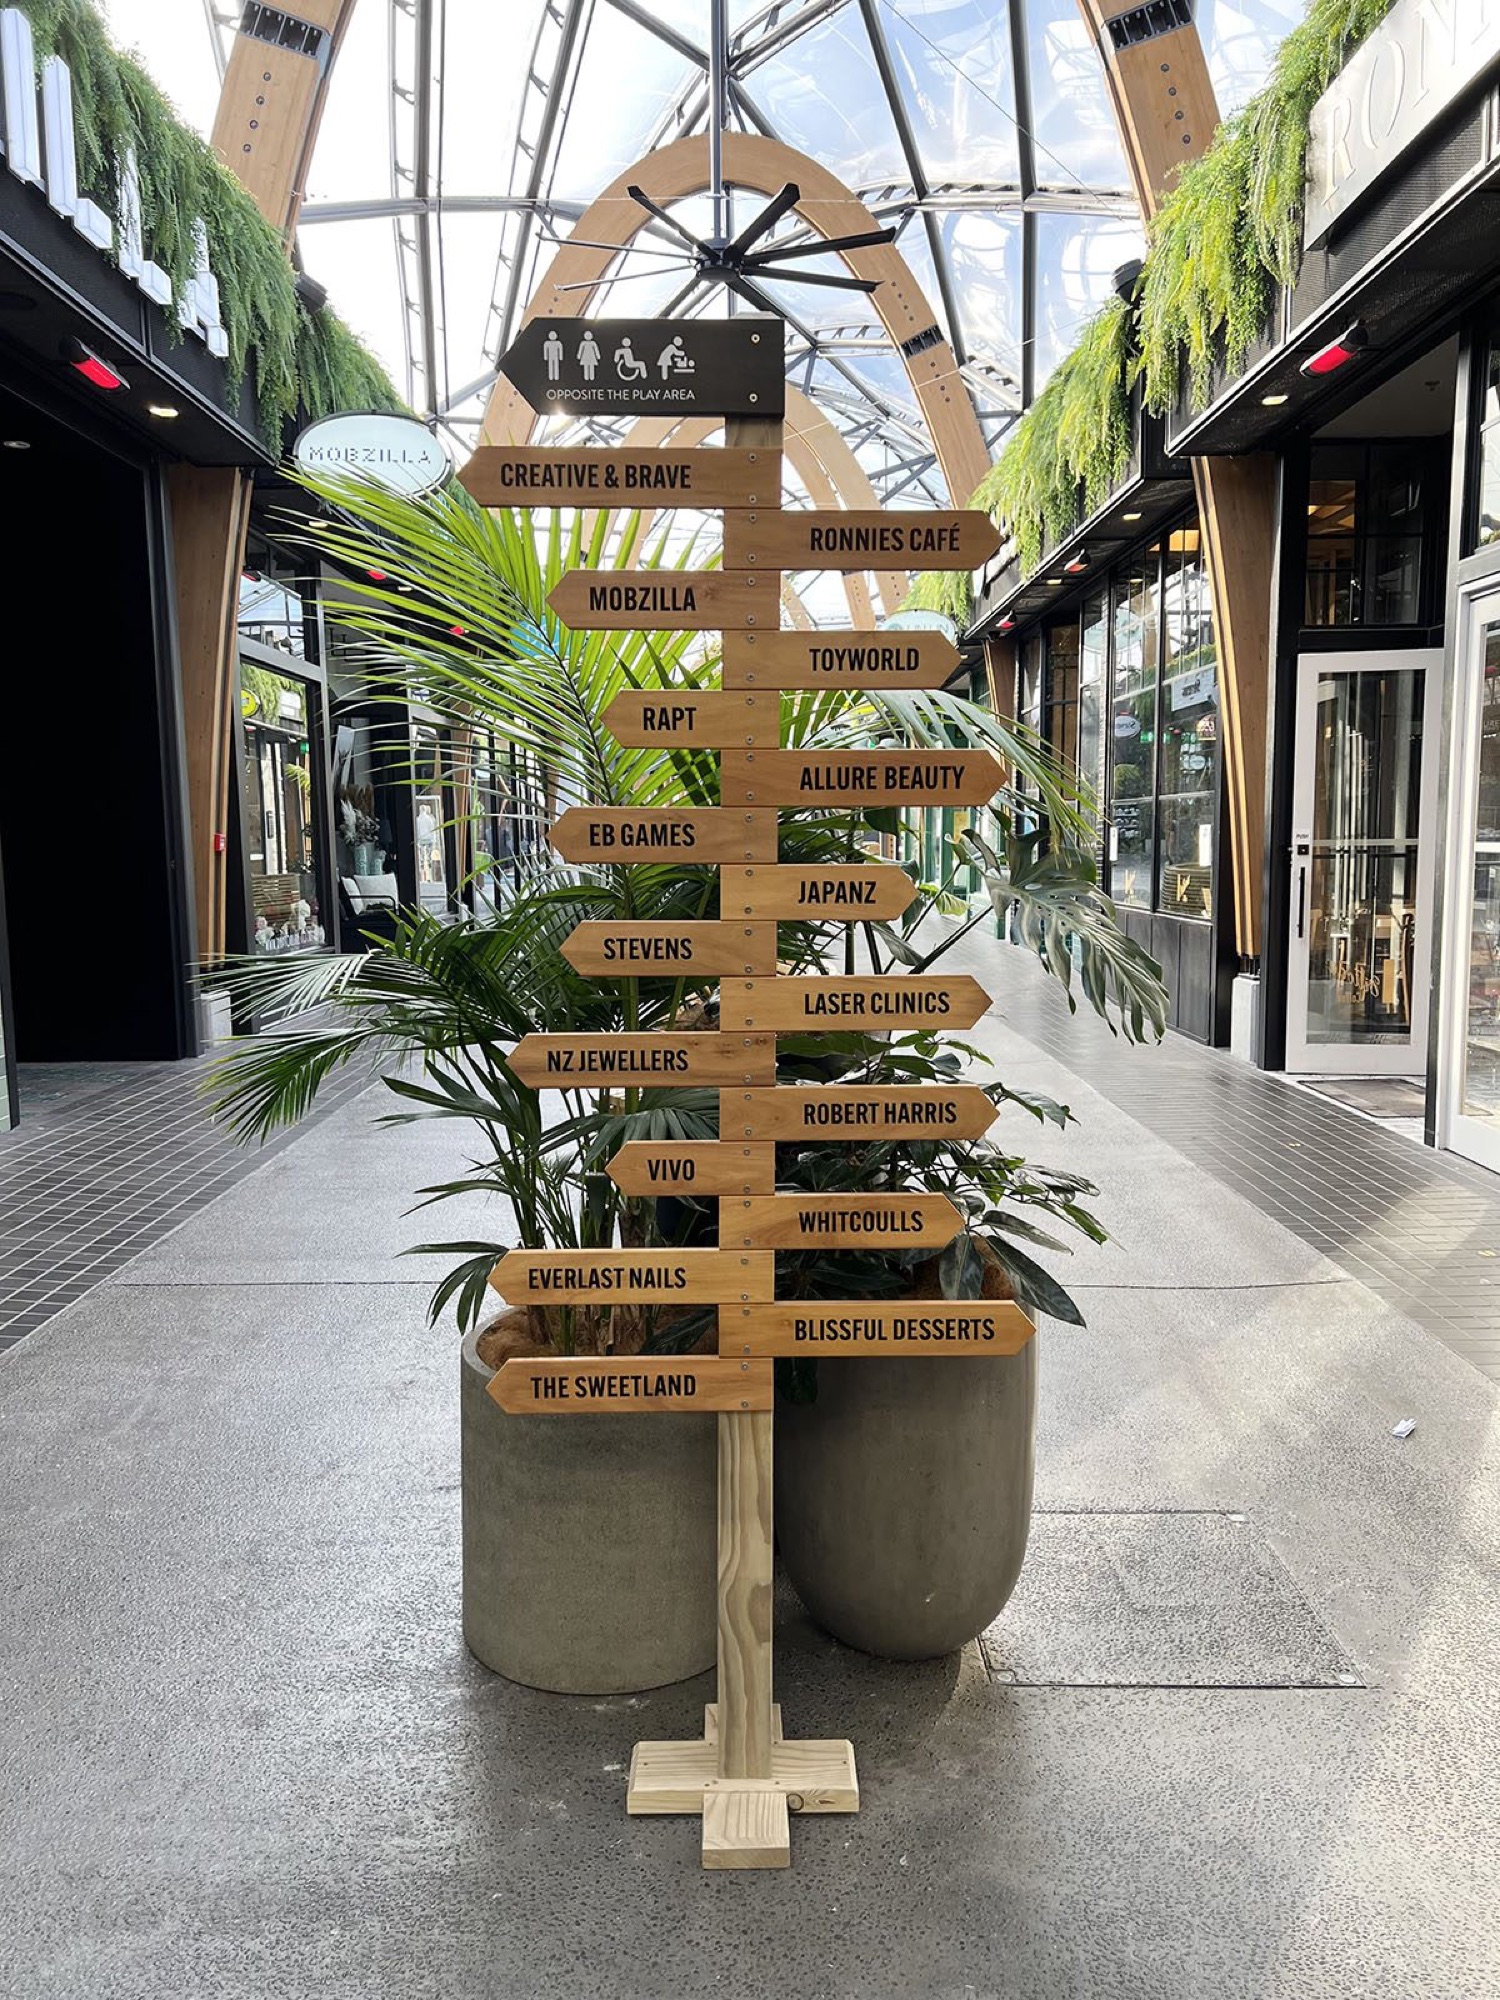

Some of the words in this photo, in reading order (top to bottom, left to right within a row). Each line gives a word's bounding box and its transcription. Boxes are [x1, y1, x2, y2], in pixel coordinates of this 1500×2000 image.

[546, 390, 604, 401] OPPOSITE
[607, 390, 629, 400] THE
[633, 390, 660, 400] PLAY
[663, 390, 695, 399] AREA
[309, 446, 431, 465] MOBZILLA
[501, 463, 599, 488] CREATIVE
[604, 464, 619, 489] &
[625, 464, 691, 489] BRAVE
[809, 526, 904, 552] RONNIES
[910, 521, 961, 551] CAFÉ
[590, 586, 696, 611] MOBZILLA
[809, 648, 919, 671] TOYWORLD
[644, 707, 696, 730] RAPT
[800, 766, 877, 790] ALLURE
[885, 765, 965, 789] BEAUTY
[590, 824, 615, 846] EB
[621, 824, 695, 846] GAMES
[798, 881, 876, 904] JAPANZ
[604, 938, 692, 960] STEVENS
[805, 993, 865, 1014] LASER
[871, 992, 949, 1014] CLINICS
[547, 1050, 574, 1072] NZ
[578, 1050, 688, 1072] JEWELLERS
[804, 1103, 879, 1125] ROBERT
[885, 1102, 956, 1124] HARRIS
[647, 1159, 694, 1181] VIVO
[799, 1211, 923, 1233] WHITCOULLS
[529, 1268, 624, 1289] EVERLAST
[630, 1268, 686, 1289] NAILS
[795, 1319, 887, 1340] BLISSFUL
[894, 1319, 994, 1340] DESSERTS
[530, 1377, 569, 1399] THE
[575, 1375, 695, 1398] SWEETLAND
